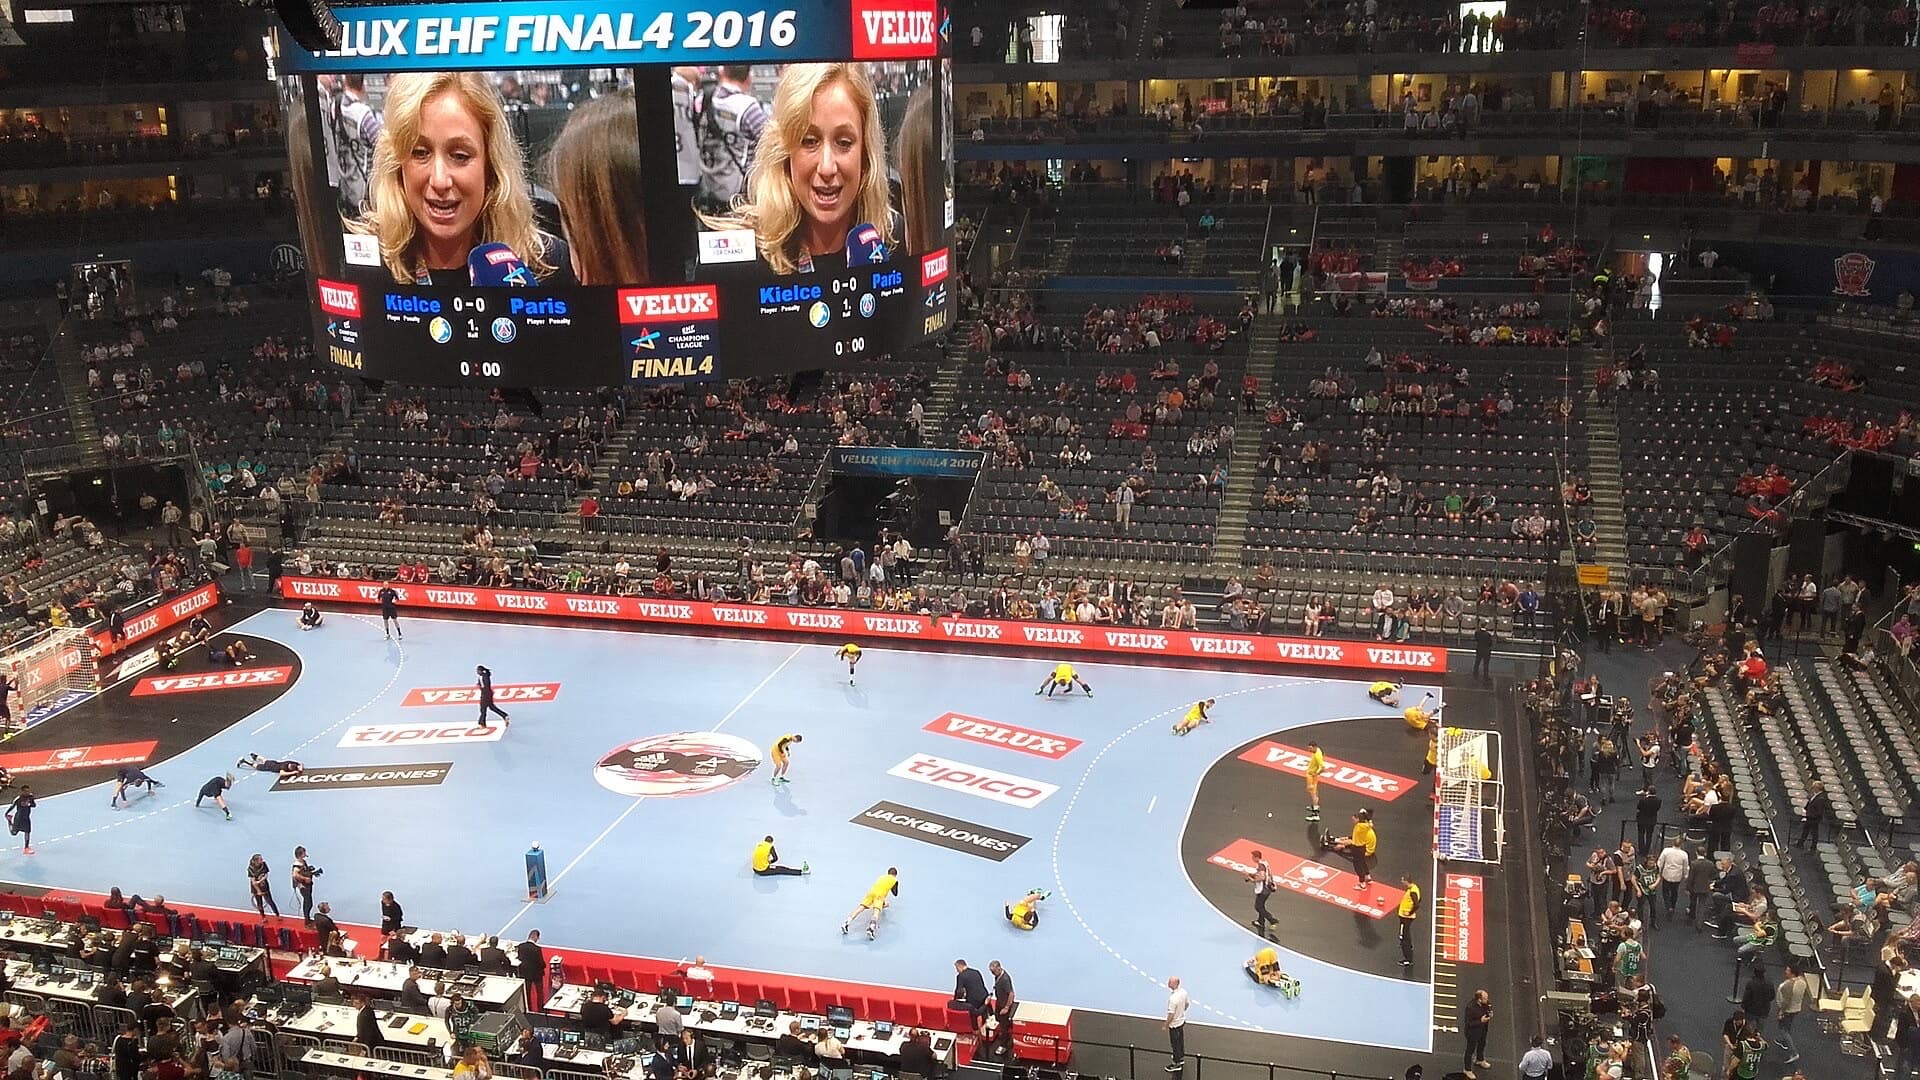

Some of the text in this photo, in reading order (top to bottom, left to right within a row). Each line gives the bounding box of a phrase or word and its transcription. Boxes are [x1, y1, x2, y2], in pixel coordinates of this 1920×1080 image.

[312, 18, 409, 58] LUX
[415, 16, 500, 55] EHF
[504, 12, 675, 53] FINAL4
[682, 10, 798, 48] 2016
[861, 10, 935, 45] VELUX
[872, 270, 903, 289] Paris
[320, 286, 357, 311] VELUX
[385, 294, 441, 313] Kielce
[760, 284, 822, 304] Kielce
[510, 298, 567, 314] Paris
[625, 292, 714, 316] VELUX
[668, 334, 710, 344] CHAMPIONS
[676, 341, 703, 350] LEAGUE
[840, 453, 878, 465] VELUX
[905, 455, 947, 468] FINAL4
[951, 457, 979, 469] 2016
[292, 581, 341, 598] VELUX
[358, 585, 408, 602] VEX
[426, 589, 476, 606] VELUX
[172, 590, 211, 618] VELUX
[494, 594, 547, 610] VELUX
[566, 598, 620, 615] VELUX
[638, 602, 693, 620] VELUX
[712, 607, 768, 625] VELUX
[787, 612, 843, 629] VELUX
[864, 617, 922, 634] VELUX
[124, 614, 160, 641] ELUX
[942, 622, 1002, 640] VELUX
[1023, 626, 1084, 645] VELUX
[1105, 631, 1168, 650] VELUX
[1190, 636, 1255, 655] VELUX
[1278, 642, 1344, 661] VELUX
[1367, 648, 1435, 668] VELUX
[150, 670, 284, 692] VELUX
[354, 727, 499, 743] tipico
[943, 717, 1067, 753] VELUX
[908, 759, 1042, 799] tipico
[1213, 855, 1386, 917] engeert strauss
[1458, 928, 1470, 961] strauss
